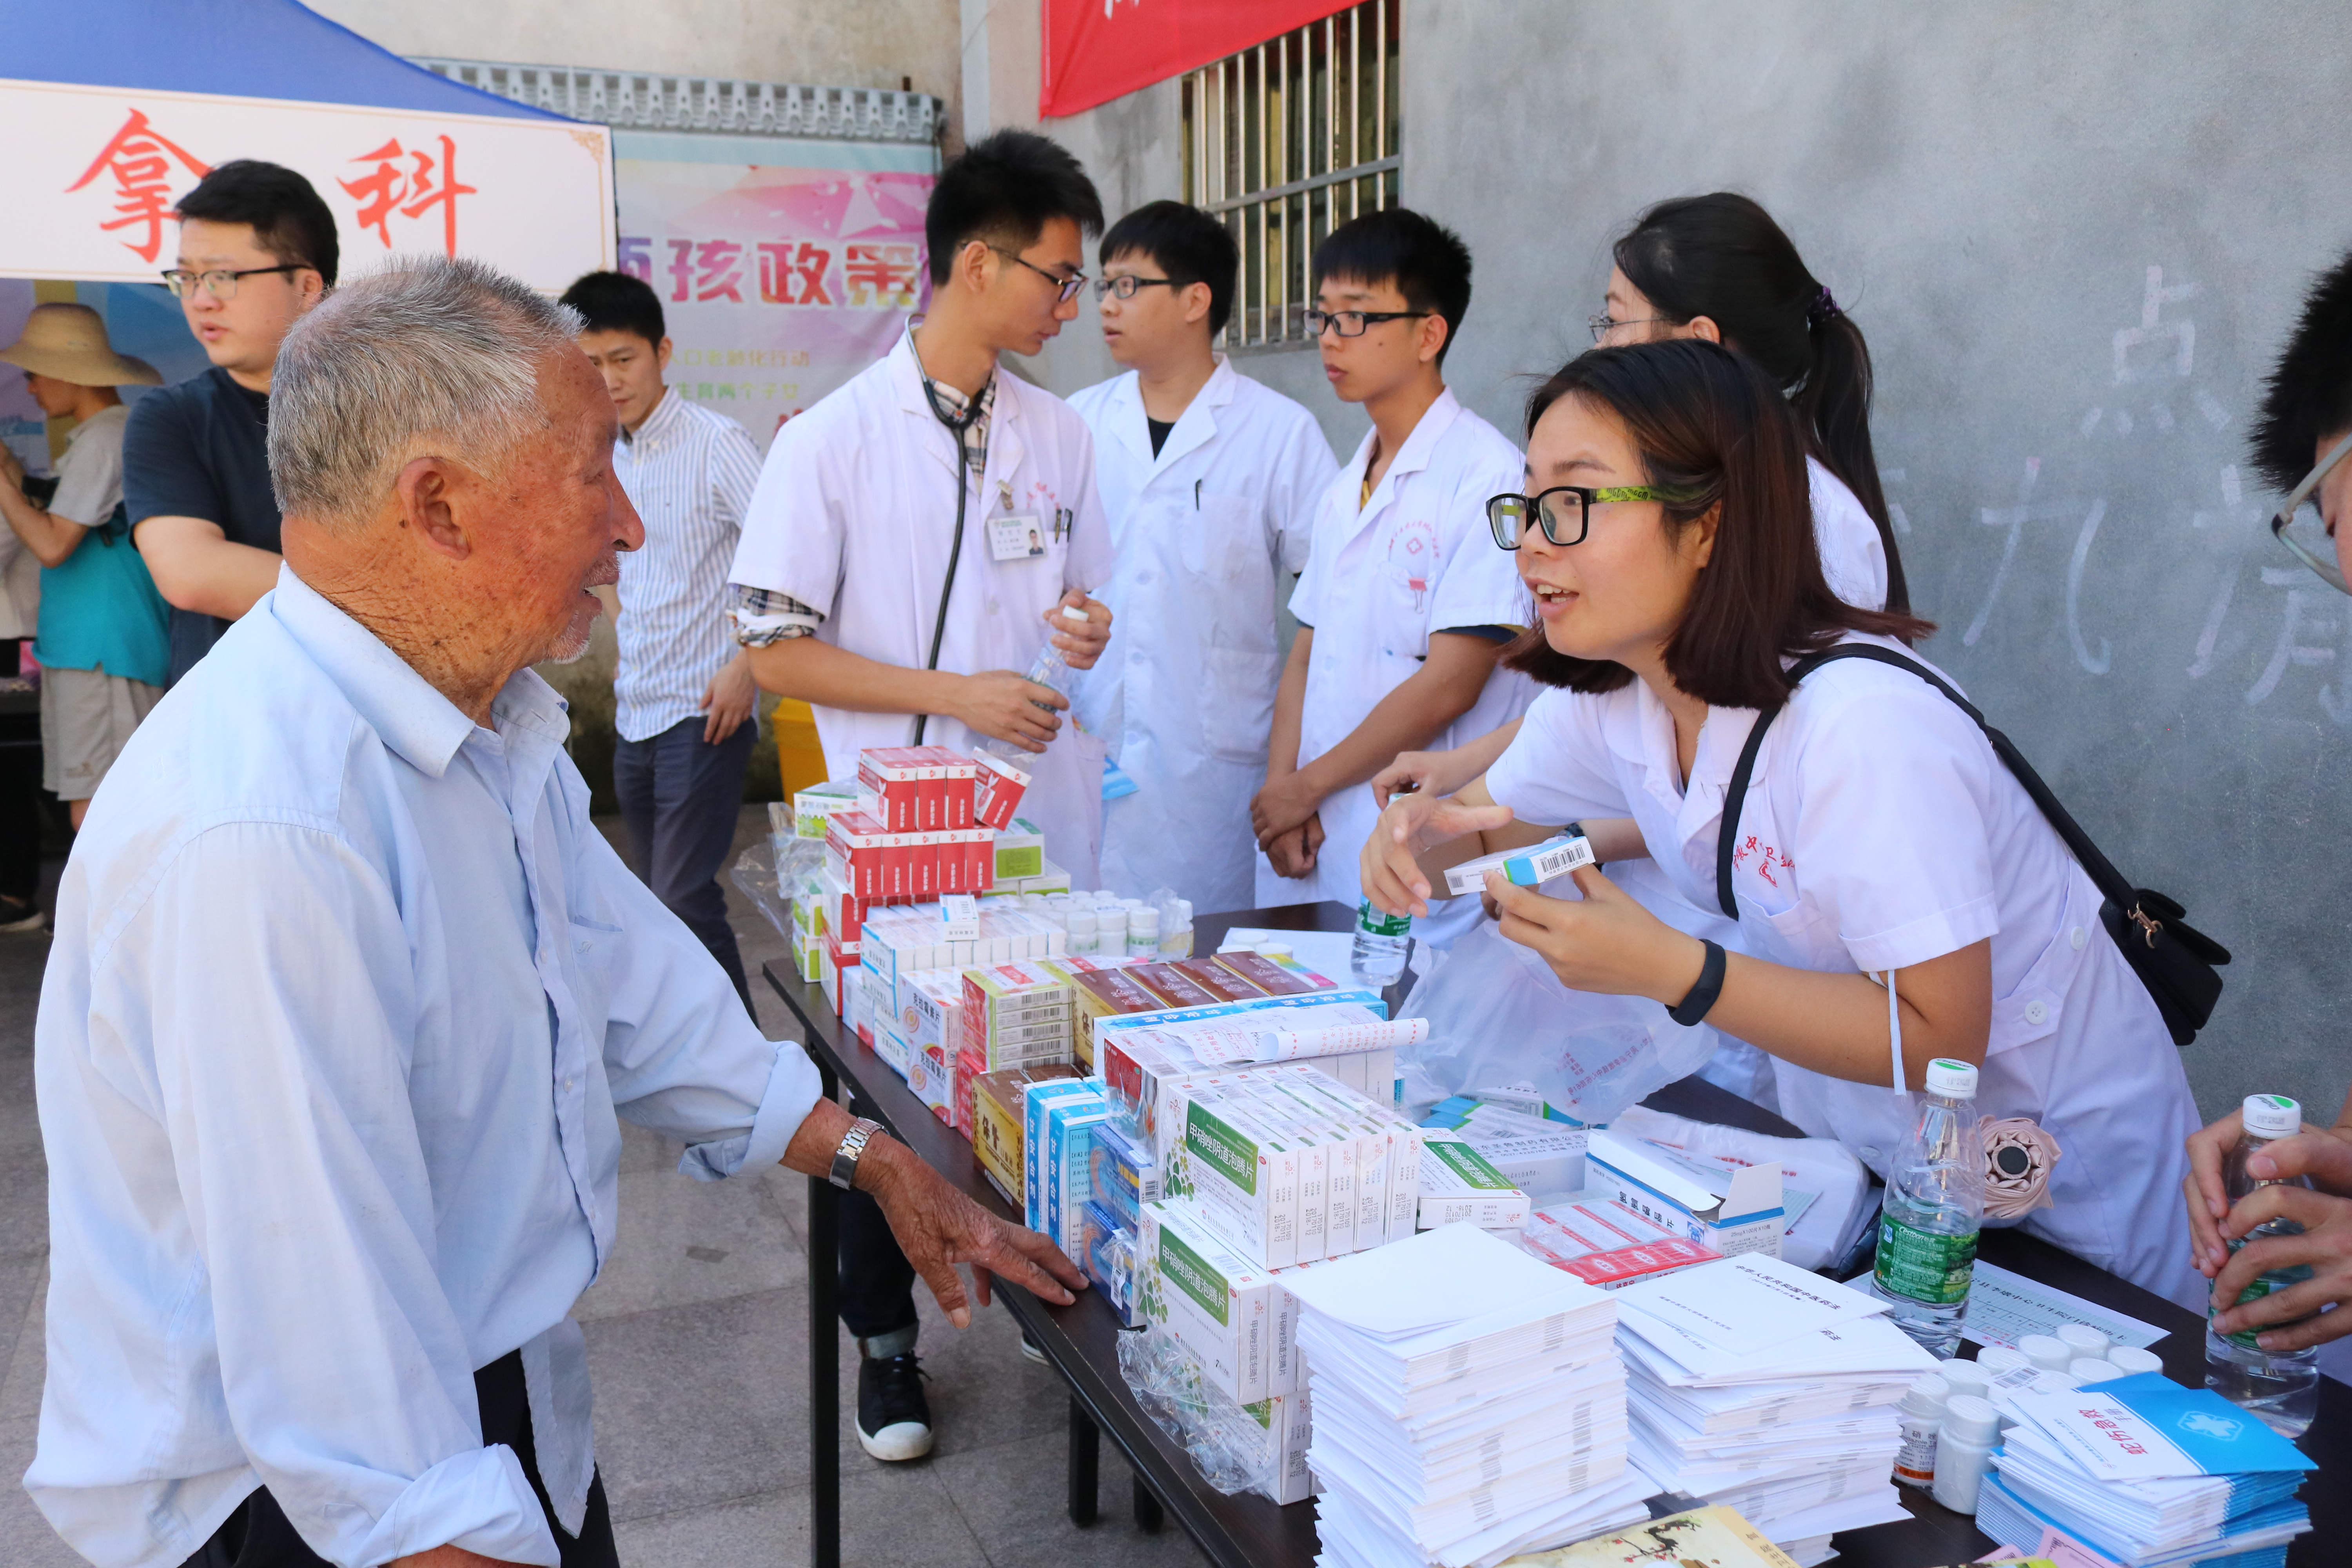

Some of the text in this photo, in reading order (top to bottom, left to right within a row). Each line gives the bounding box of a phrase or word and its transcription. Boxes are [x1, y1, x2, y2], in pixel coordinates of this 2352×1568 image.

[913, 993, 940, 1024] 克拉霉素片
[920, 1051, 946, 1085] 克拉霉素片
[1190, 1122, 1254, 1182] 甲硝唑阴道泡腾片
[1437, 1143, 1499, 1189] 甲硝唑阴道泡腾片
[1899, 1227, 1924, 1240] Cestbon
[1163, 1244, 1225, 1313] 甲硝唑阴道泡腾片
[1735, 1265, 1842, 1310] 中华人民共和国中医药法
[1249, 1320, 1258, 1384] 甲硝唑阴道泡腾片
[1279, 1312, 1287, 1376] 甲硝唑阴道泡腾片
[2078, 1409, 2149, 1455] 蛇伤急救
